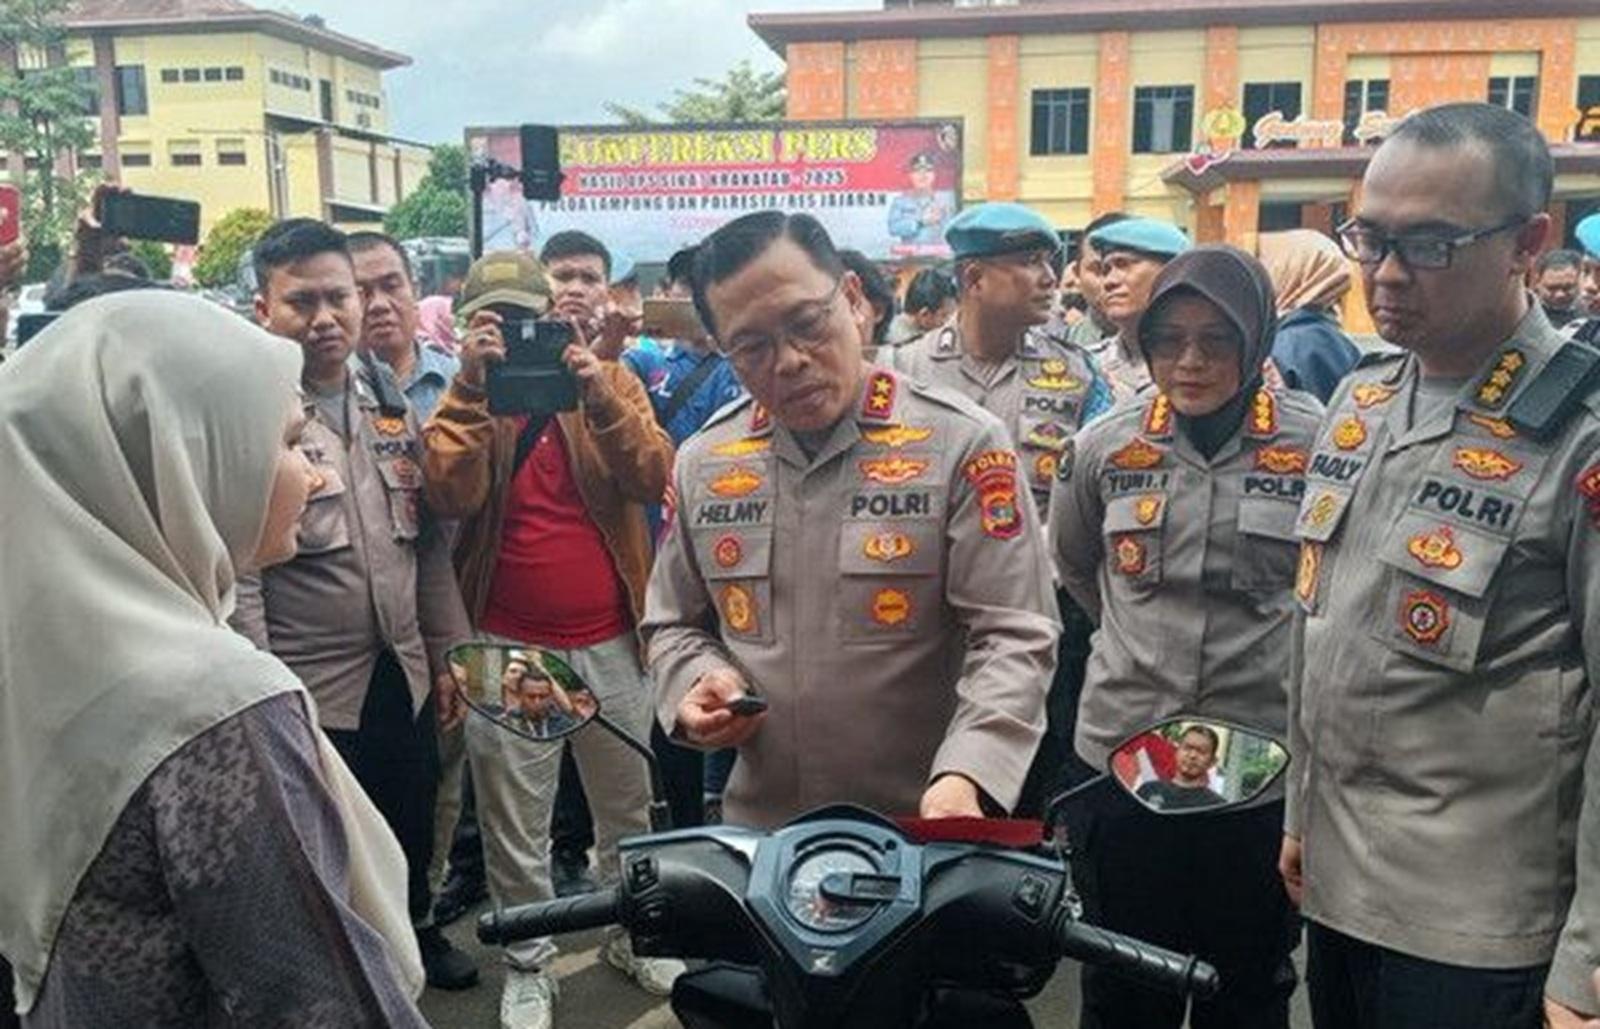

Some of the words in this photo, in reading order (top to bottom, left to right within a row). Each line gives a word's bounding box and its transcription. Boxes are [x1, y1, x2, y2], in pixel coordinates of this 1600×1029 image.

[781, 128, 877, 163] PERS
[804, 170, 844, 185] 2025
[591, 198, 662, 210] LAMPUNG
[667, 197, 697, 210] DAN
[1244, 477, 1306, 498] POLR
[697, 501, 767, 524] HELMY
[851, 493, 930, 516] POLRI
[1417, 480, 1514, 528] POLRI
